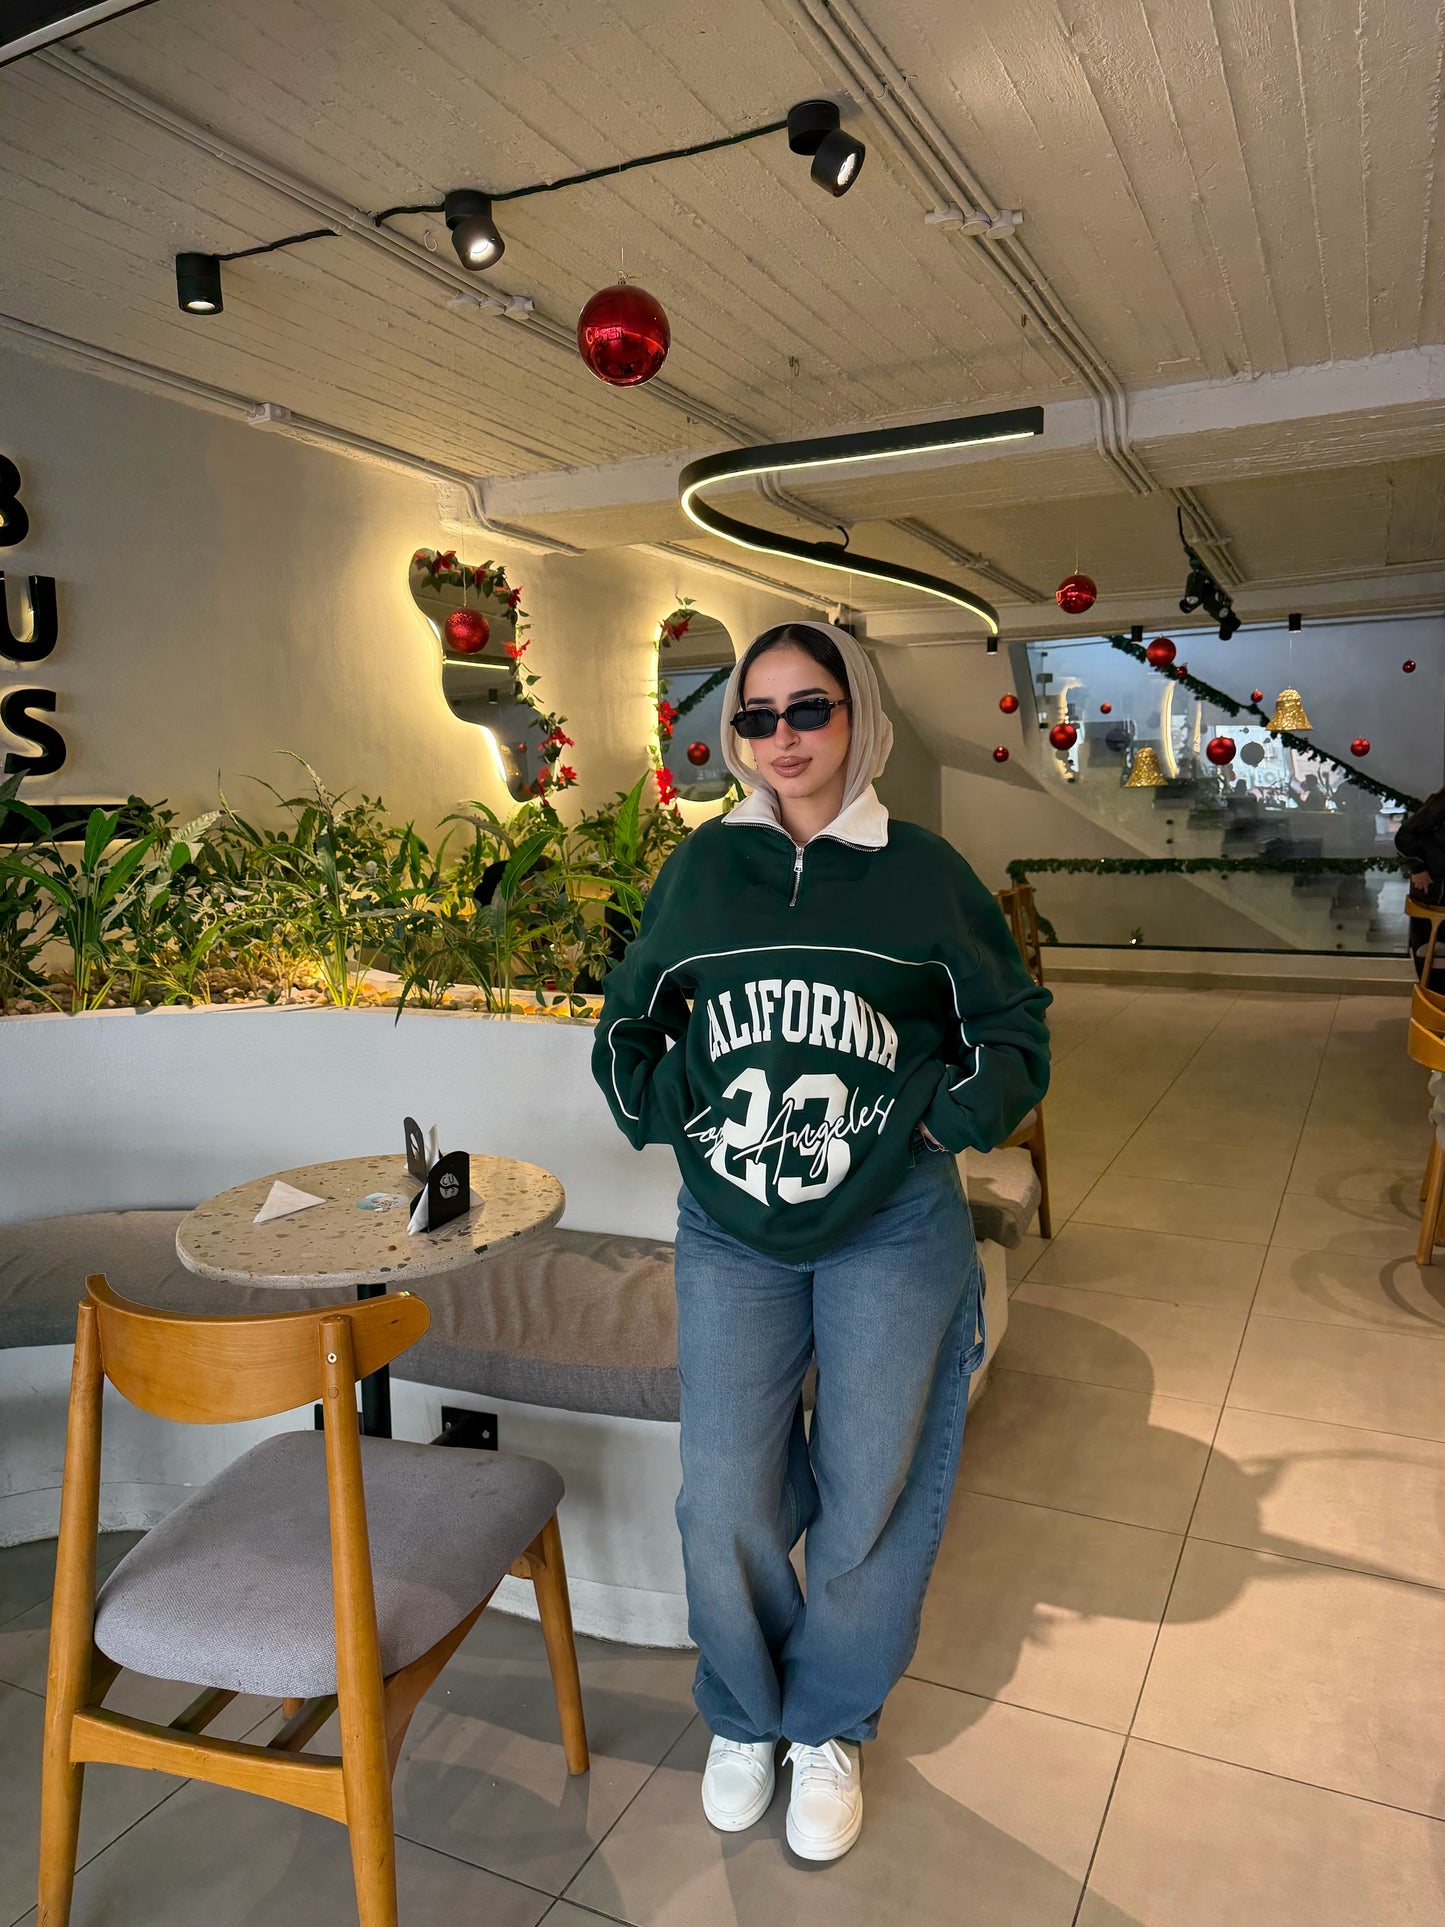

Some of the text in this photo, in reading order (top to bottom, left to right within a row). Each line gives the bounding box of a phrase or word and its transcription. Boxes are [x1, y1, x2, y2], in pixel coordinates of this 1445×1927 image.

[706, 979, 898, 1072] ALIFORNIA
[710, 1067, 850, 1206] 23
[732, 1086, 895, 1185] Angeles
